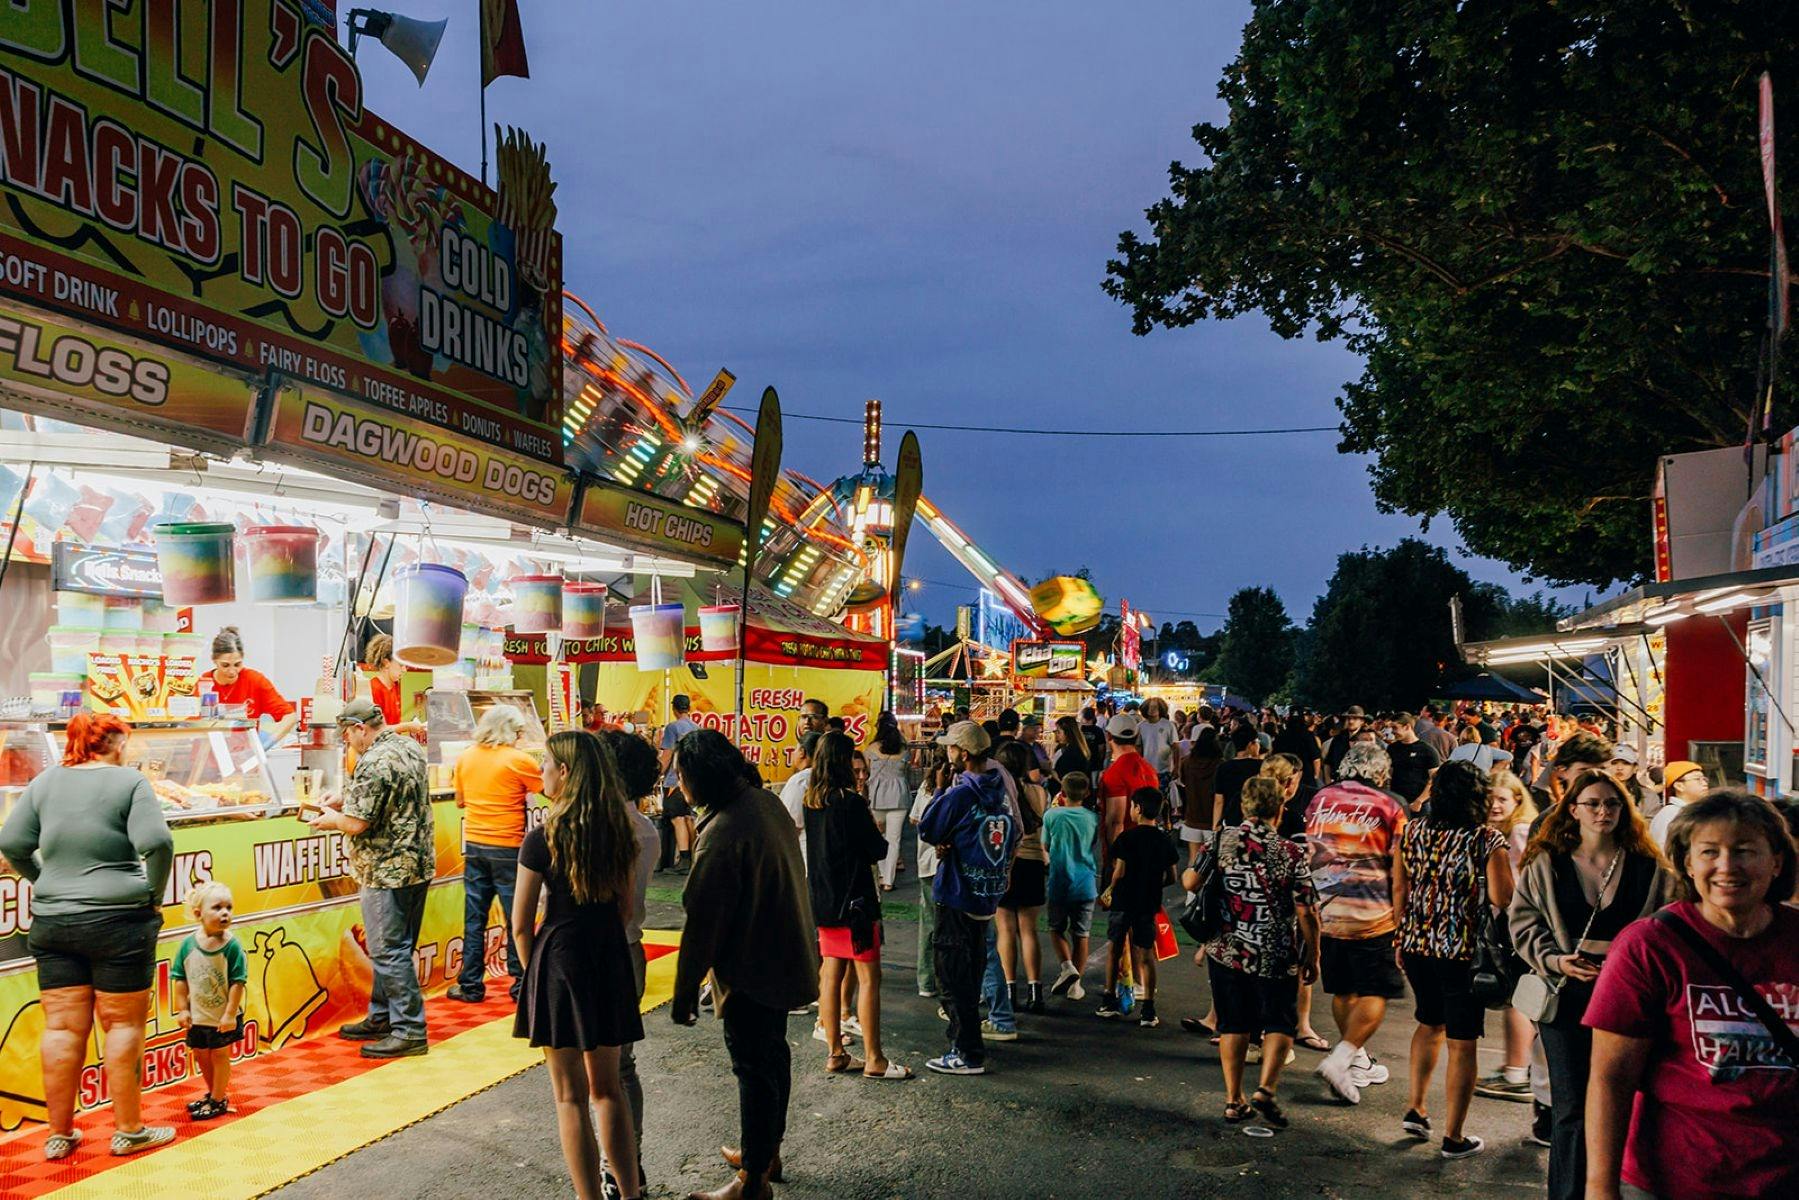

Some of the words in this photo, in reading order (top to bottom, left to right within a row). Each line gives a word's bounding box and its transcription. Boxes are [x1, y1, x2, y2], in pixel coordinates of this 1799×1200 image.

[0, 0, 362, 220] ELL'S
[0, 68, 219, 264] NACKS
[233, 181, 302, 299] TO
[315, 225, 380, 330] GO
[441, 225, 511, 314] COLD
[0, 317, 171, 407] FLOSS
[54, 269, 119, 319] DRINK
[147, 302, 238, 356] LOLLIPOPS
[259, 341, 302, 373] FAIRY
[305, 356, 346, 390] FLOSS
[363, 376, 405, 410] TOFFEE
[409, 393, 448, 425] APPLES
[462, 411, 501, 440] DONUTS
[513, 429, 552, 459] WAFFLES
[420, 287, 530, 389] DRINKS
[301, 401, 480, 484] DAGWOOD
[483, 458, 556, 506] DOGS
[625, 501, 664, 534] HOT
[664, 513, 715, 547] CHIPS
[502, 639, 529, 654] RESH
[534, 639, 581, 655] POTO
[584, 636, 619, 653] CHIPS
[750, 688, 805, 709] FRESH
[1696, 992, 1799, 1019] ALH
[80, 1041, 188, 1110] SCKS
